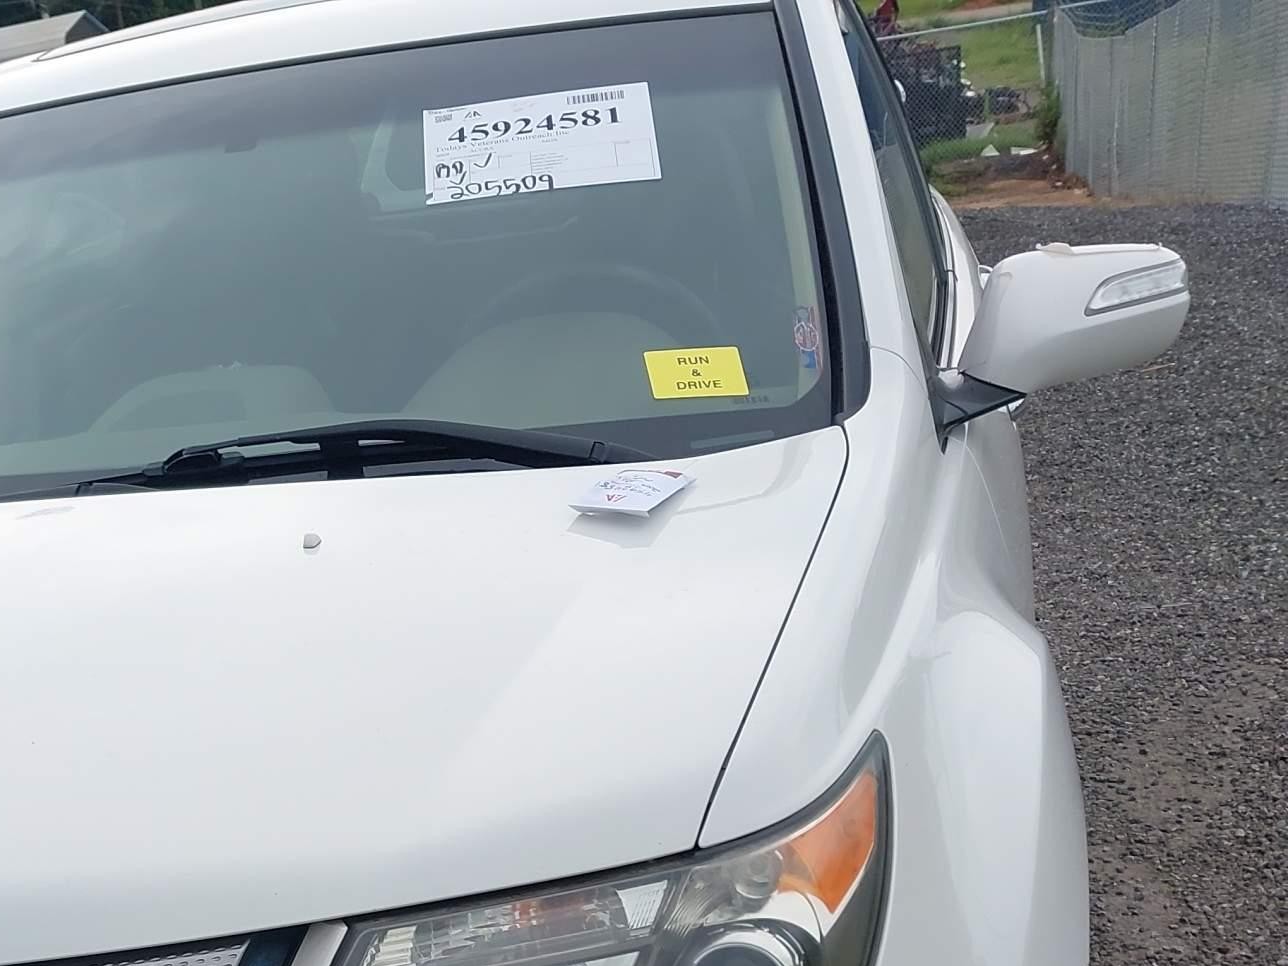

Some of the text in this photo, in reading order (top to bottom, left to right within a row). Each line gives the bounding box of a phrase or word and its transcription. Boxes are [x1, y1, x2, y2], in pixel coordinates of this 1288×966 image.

[447, 106, 622, 143] 45924581
[447, 173, 554, 200] 205509
[677, 355, 710, 366] RUN
[691, 368, 702, 377] &
[676, 379, 723, 391] DRIVE
